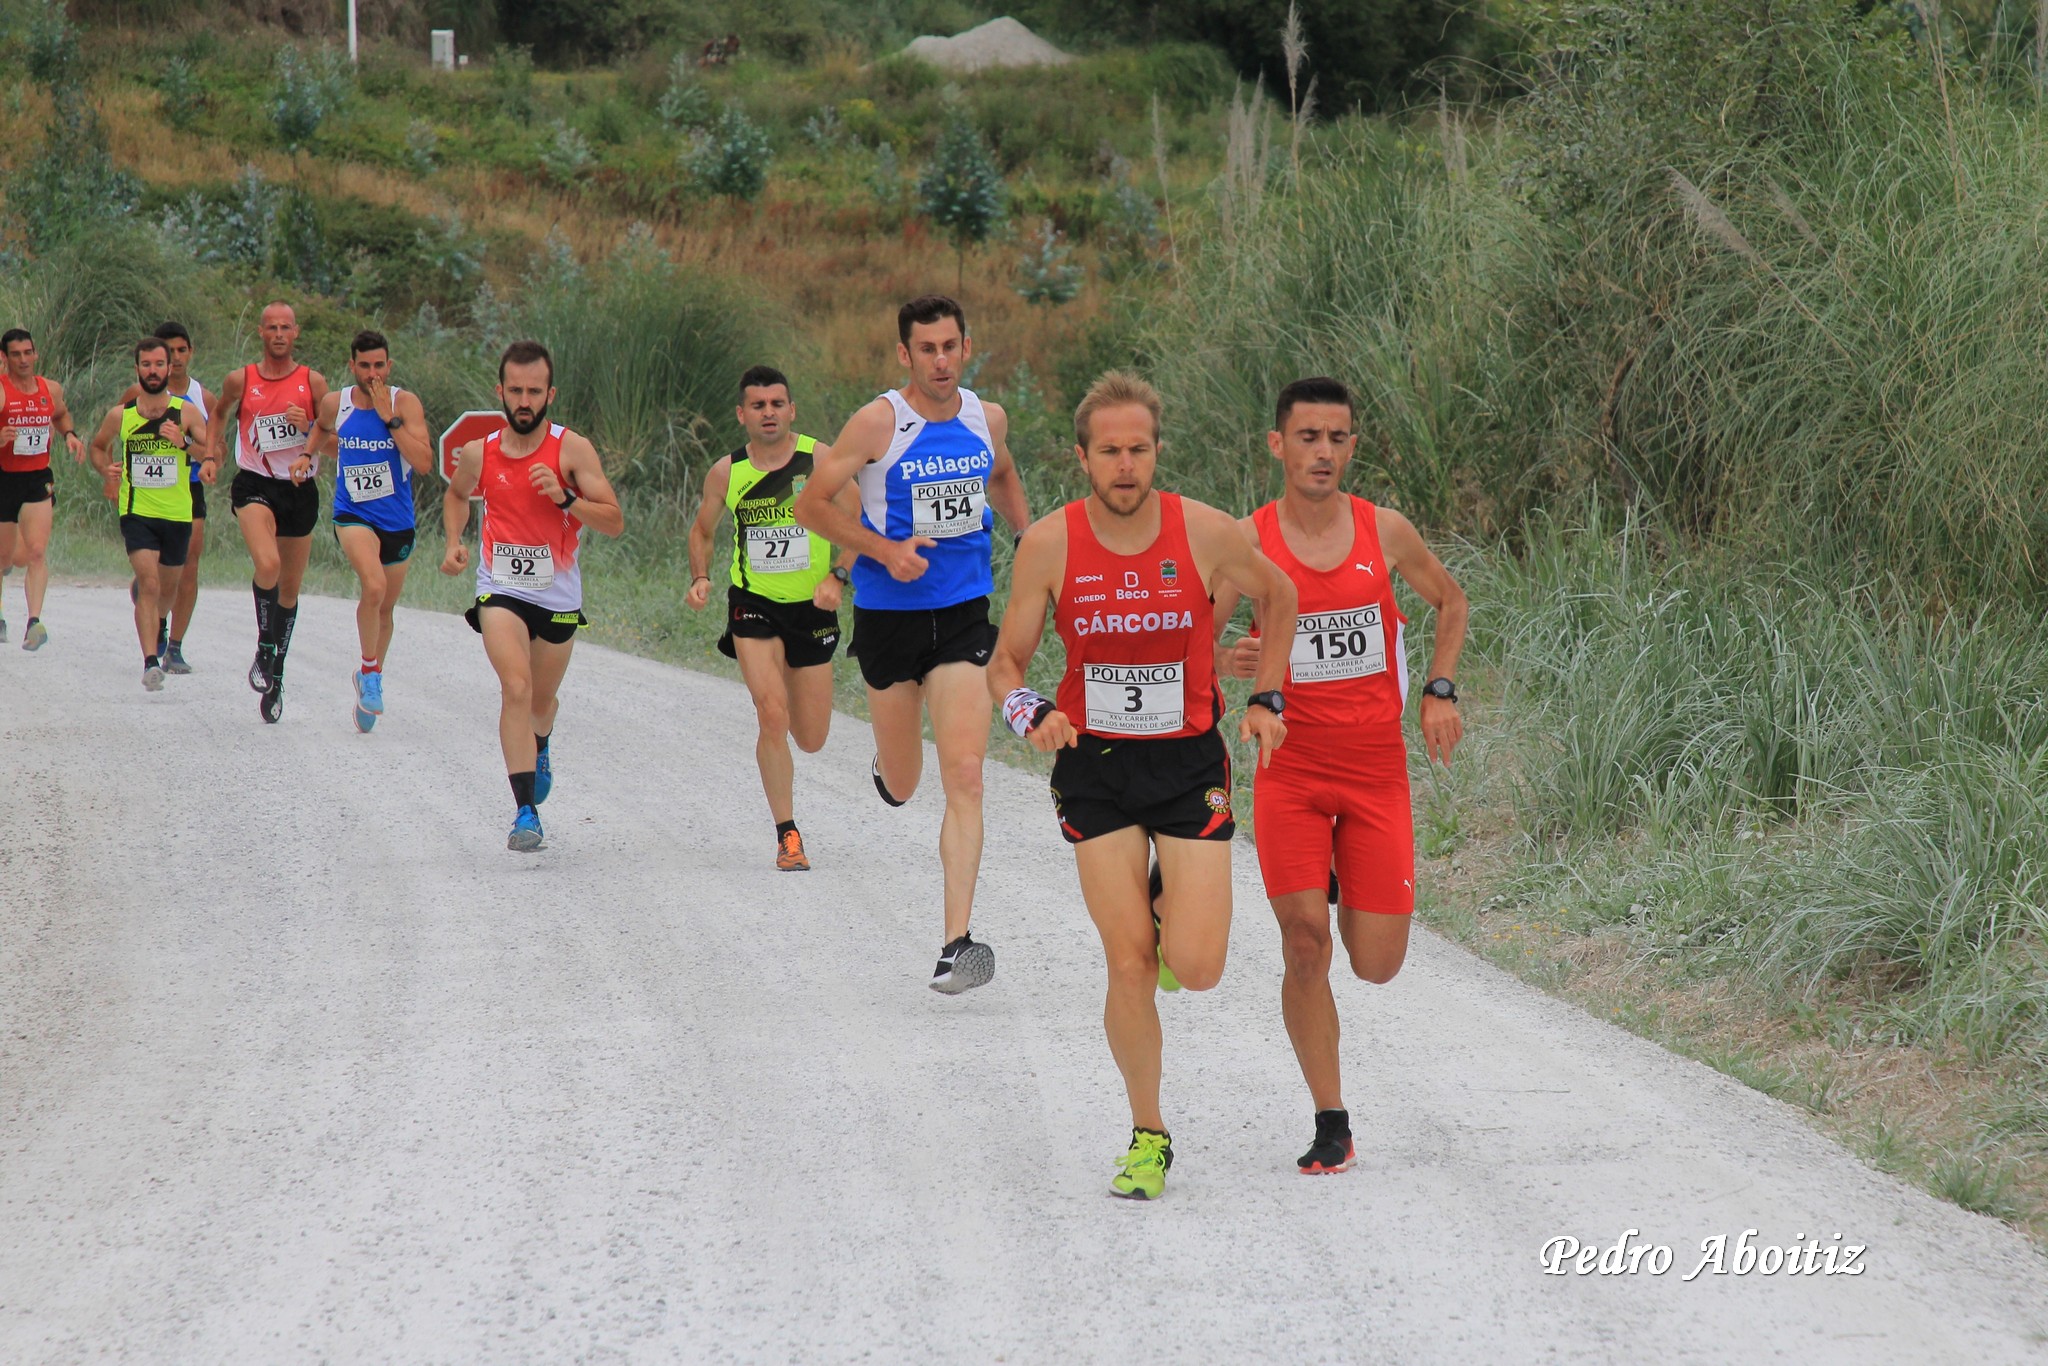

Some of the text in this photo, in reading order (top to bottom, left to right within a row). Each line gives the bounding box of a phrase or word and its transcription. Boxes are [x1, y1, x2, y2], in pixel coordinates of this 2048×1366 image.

[268, 424, 297, 440] 130
[28, 435, 40, 446] 13
[144, 466, 164, 478] 44
[346, 464, 387, 475] POLANCO
[354, 475, 382, 490] 126
[918, 482, 980, 498] POLANCO
[740, 506, 794, 524] MAINS
[930, 496, 972, 522] 154
[750, 527, 804, 540] POLANCO
[496, 546, 549, 557] POLANCO
[765, 540, 790, 558] 27
[511, 558, 536, 575] 92
[1074, 594, 1106, 604] LOREDO
[1116, 588, 1150, 600] Beco
[1074, 611, 1193, 636] CÁRCOBA
[1296, 610, 1376, 631] POLANCO
[1310, 630, 1366, 660] 150
[1330, 660, 1364, 668] CARRERA
[1092, 667, 1176, 682] POLANCO
[1124, 686, 1143, 712] 3
